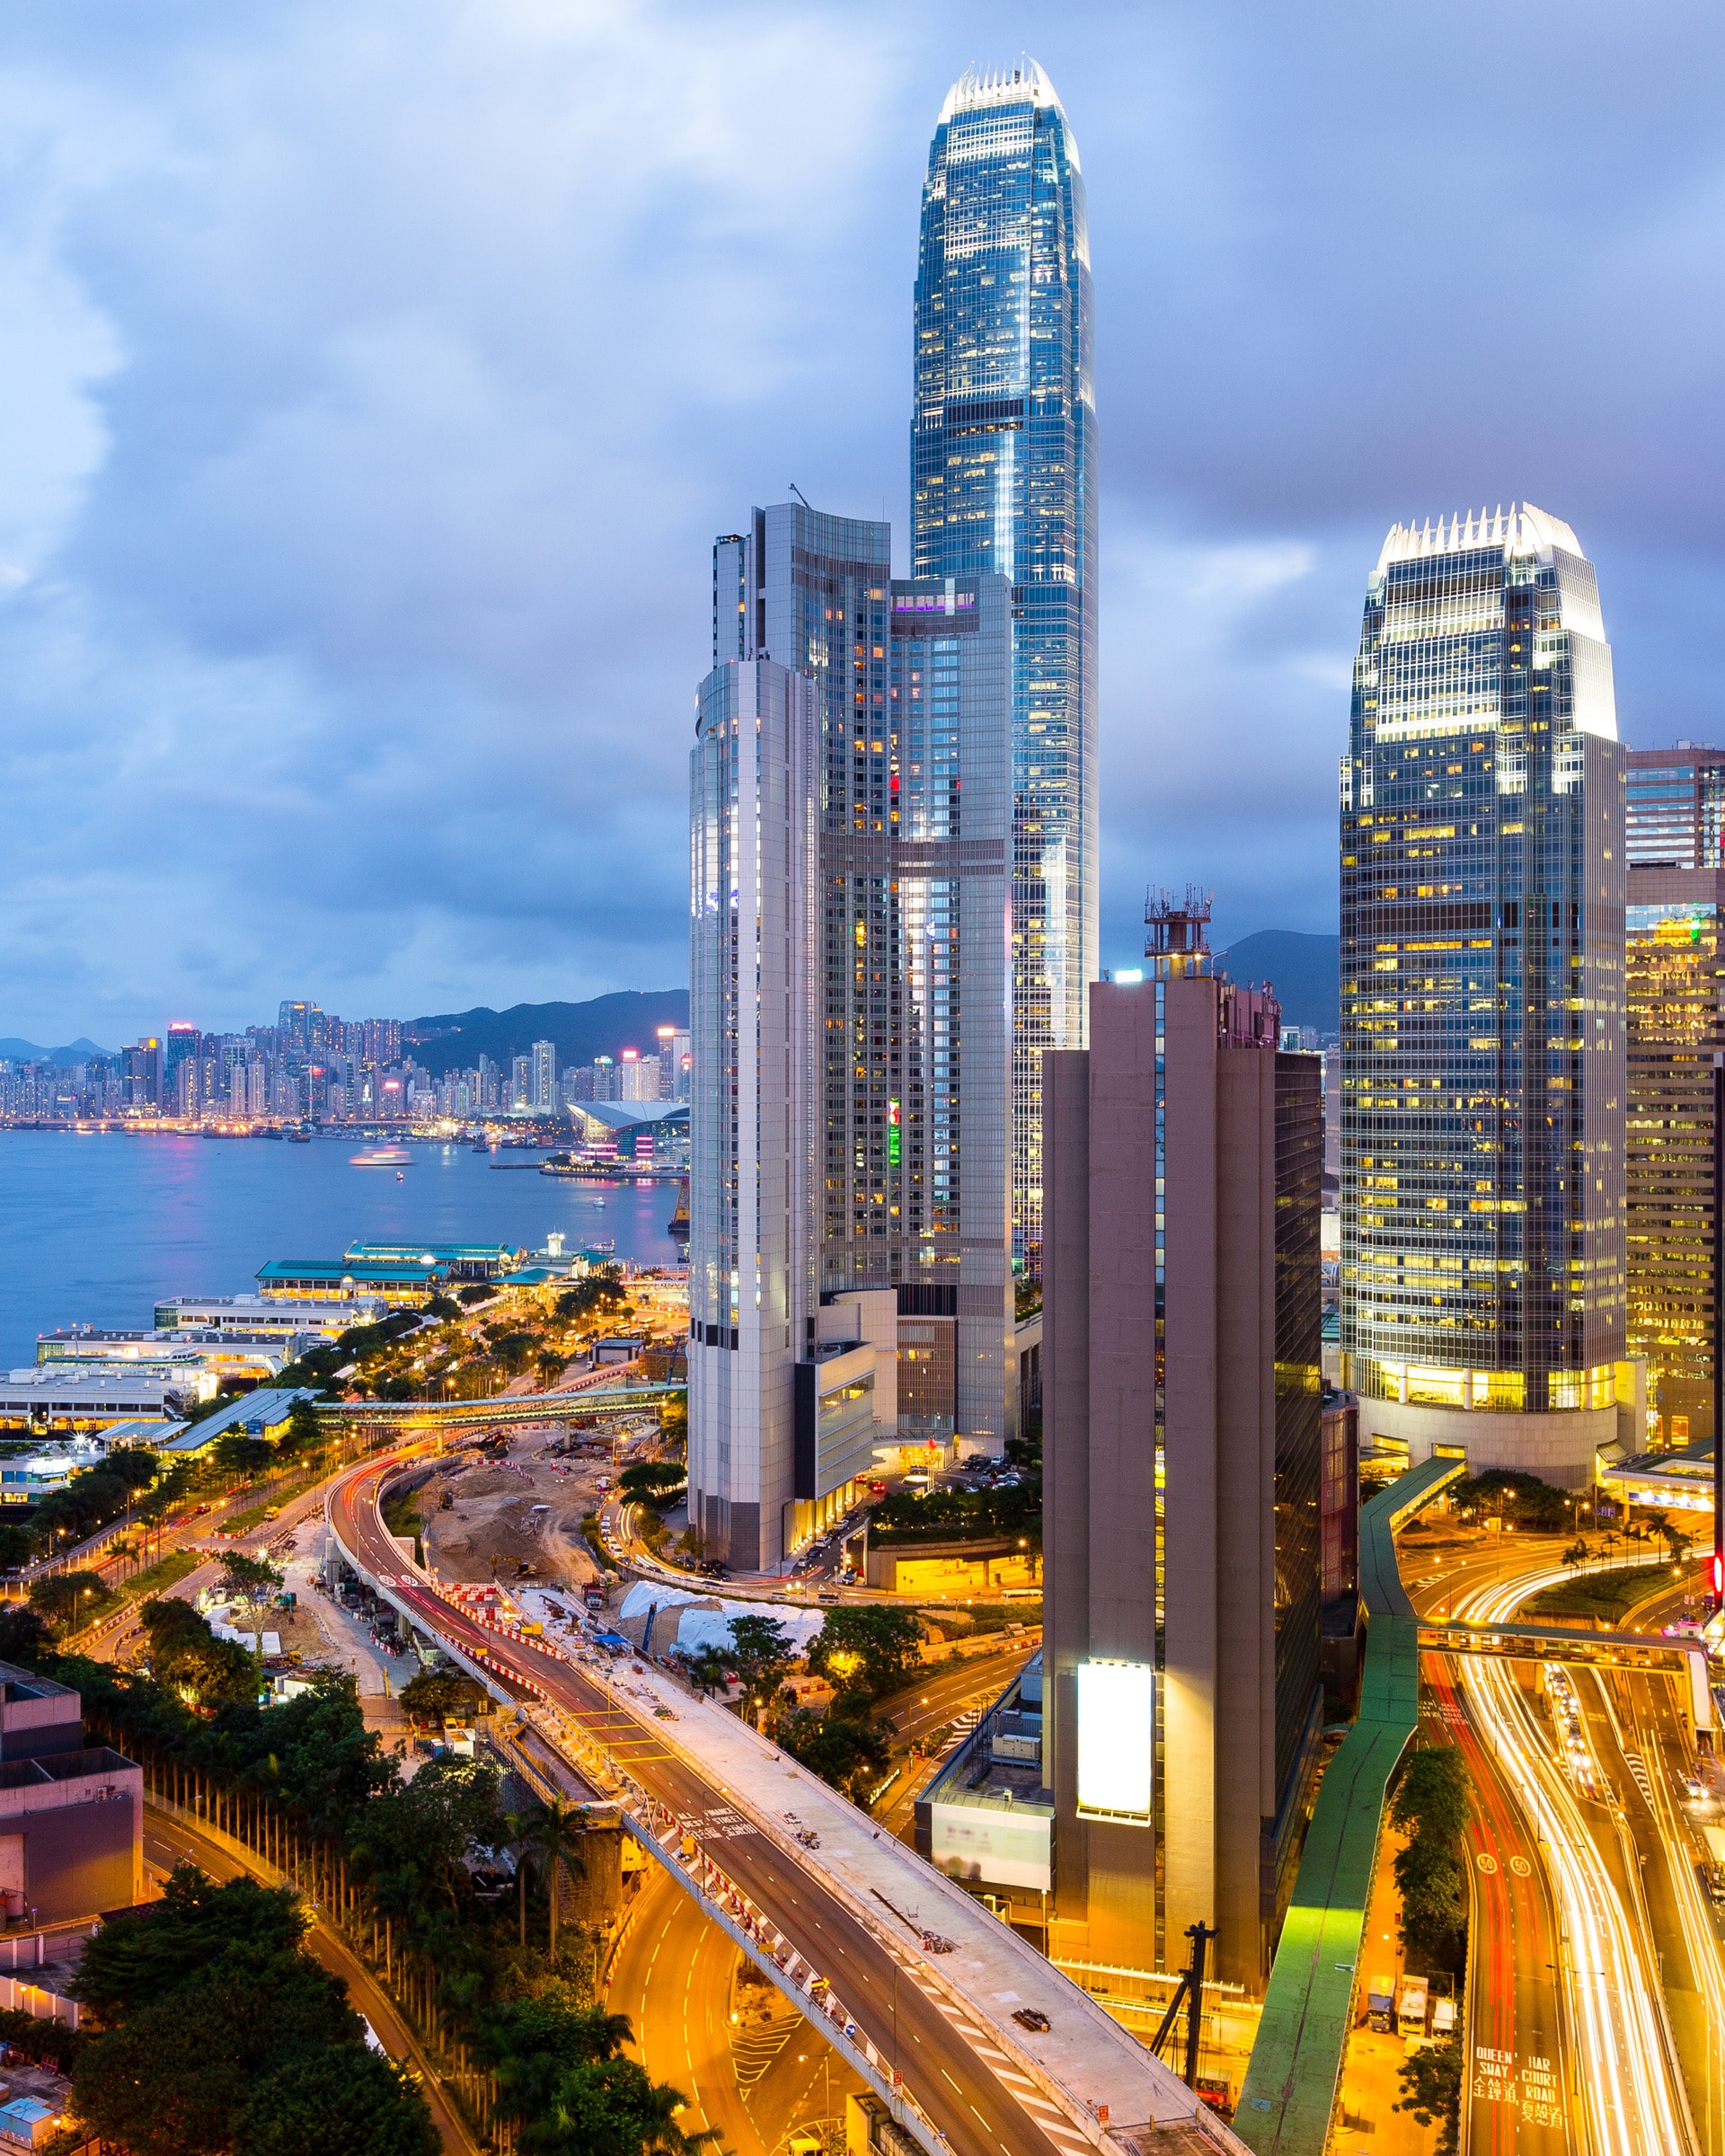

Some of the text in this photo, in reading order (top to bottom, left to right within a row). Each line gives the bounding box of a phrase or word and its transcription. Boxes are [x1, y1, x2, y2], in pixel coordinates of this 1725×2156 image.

[704, 1807, 737, 1816] FINANCE
[712, 1815, 743, 1825] STREET
[1481, 1859, 1492, 1869] 50
[1515, 1860, 1526, 1871] 50
[1476, 2046, 1512, 2064] QUEEN
[1480, 2062, 1508, 2078] SWAY
[1528, 2055, 1551, 2072] HAR
[1521, 2069, 1557, 2089] COURT
[1526, 2084, 1555, 2103] ROAD
